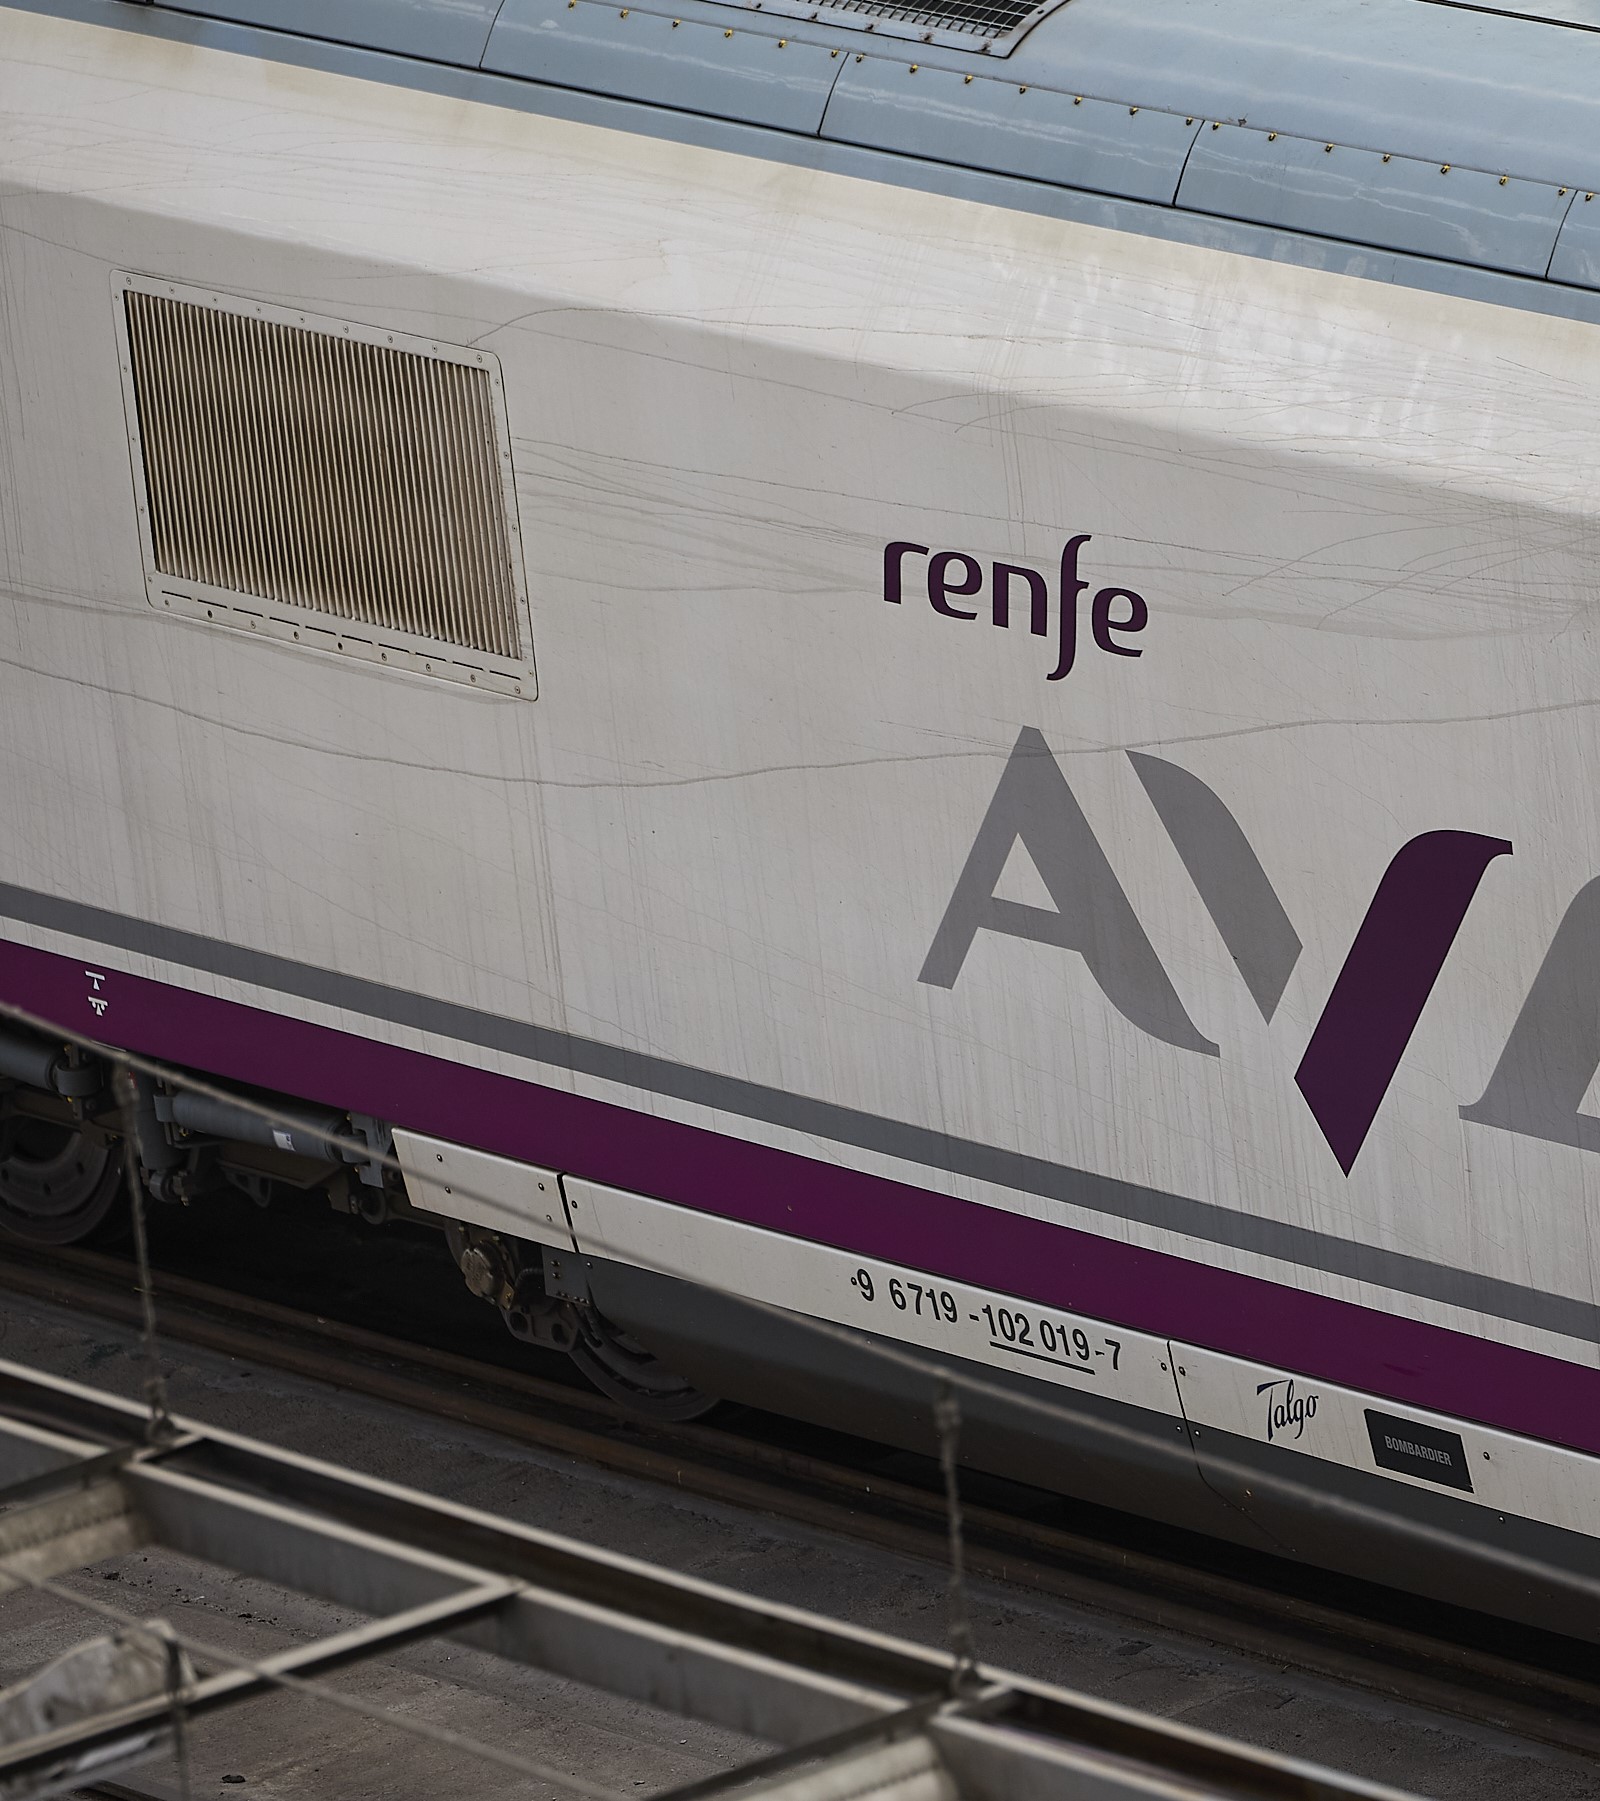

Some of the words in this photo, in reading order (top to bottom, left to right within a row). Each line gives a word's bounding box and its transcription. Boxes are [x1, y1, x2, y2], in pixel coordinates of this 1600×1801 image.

[883, 534, 1148, 681] renfe
[888, 1278, 958, 1323] 6719
[1256, 1379, 1319, 1442] Talgo
[1384, 1435, 1452, 1467] BOMBARDIER
